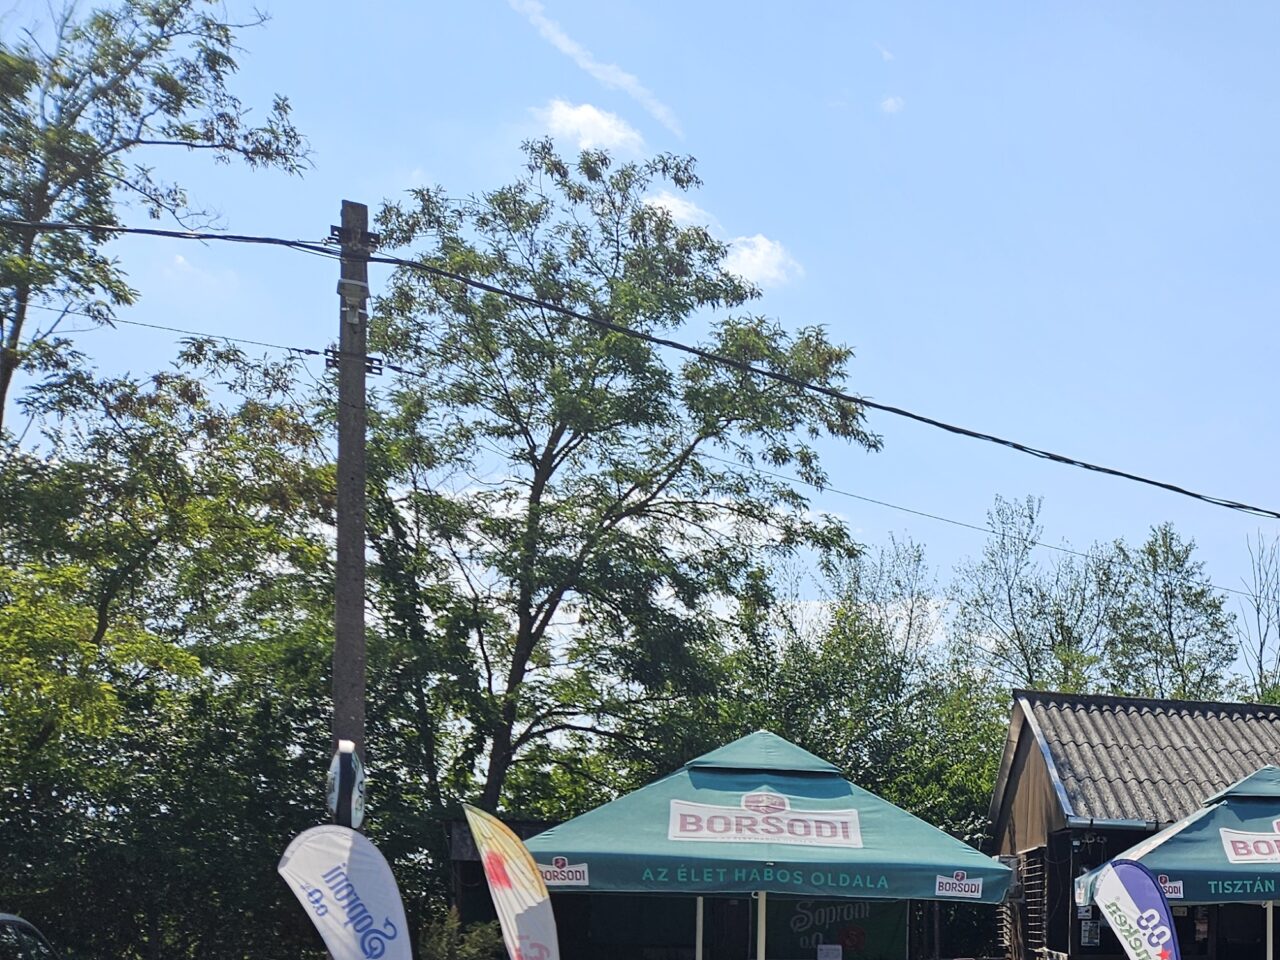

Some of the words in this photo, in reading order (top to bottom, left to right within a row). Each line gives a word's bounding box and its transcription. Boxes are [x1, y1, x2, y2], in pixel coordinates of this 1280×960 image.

[679, 813, 850, 840] BORSODI
[642, 868, 668, 882] AZ
[677, 864, 727, 882] ÉLET
[734, 868, 803, 885] HABOS
[811, 871, 889, 889] OLDALA
[1208, 876, 1275, 894] TISZTÁN
[938, 881, 979, 894] BORSODI
